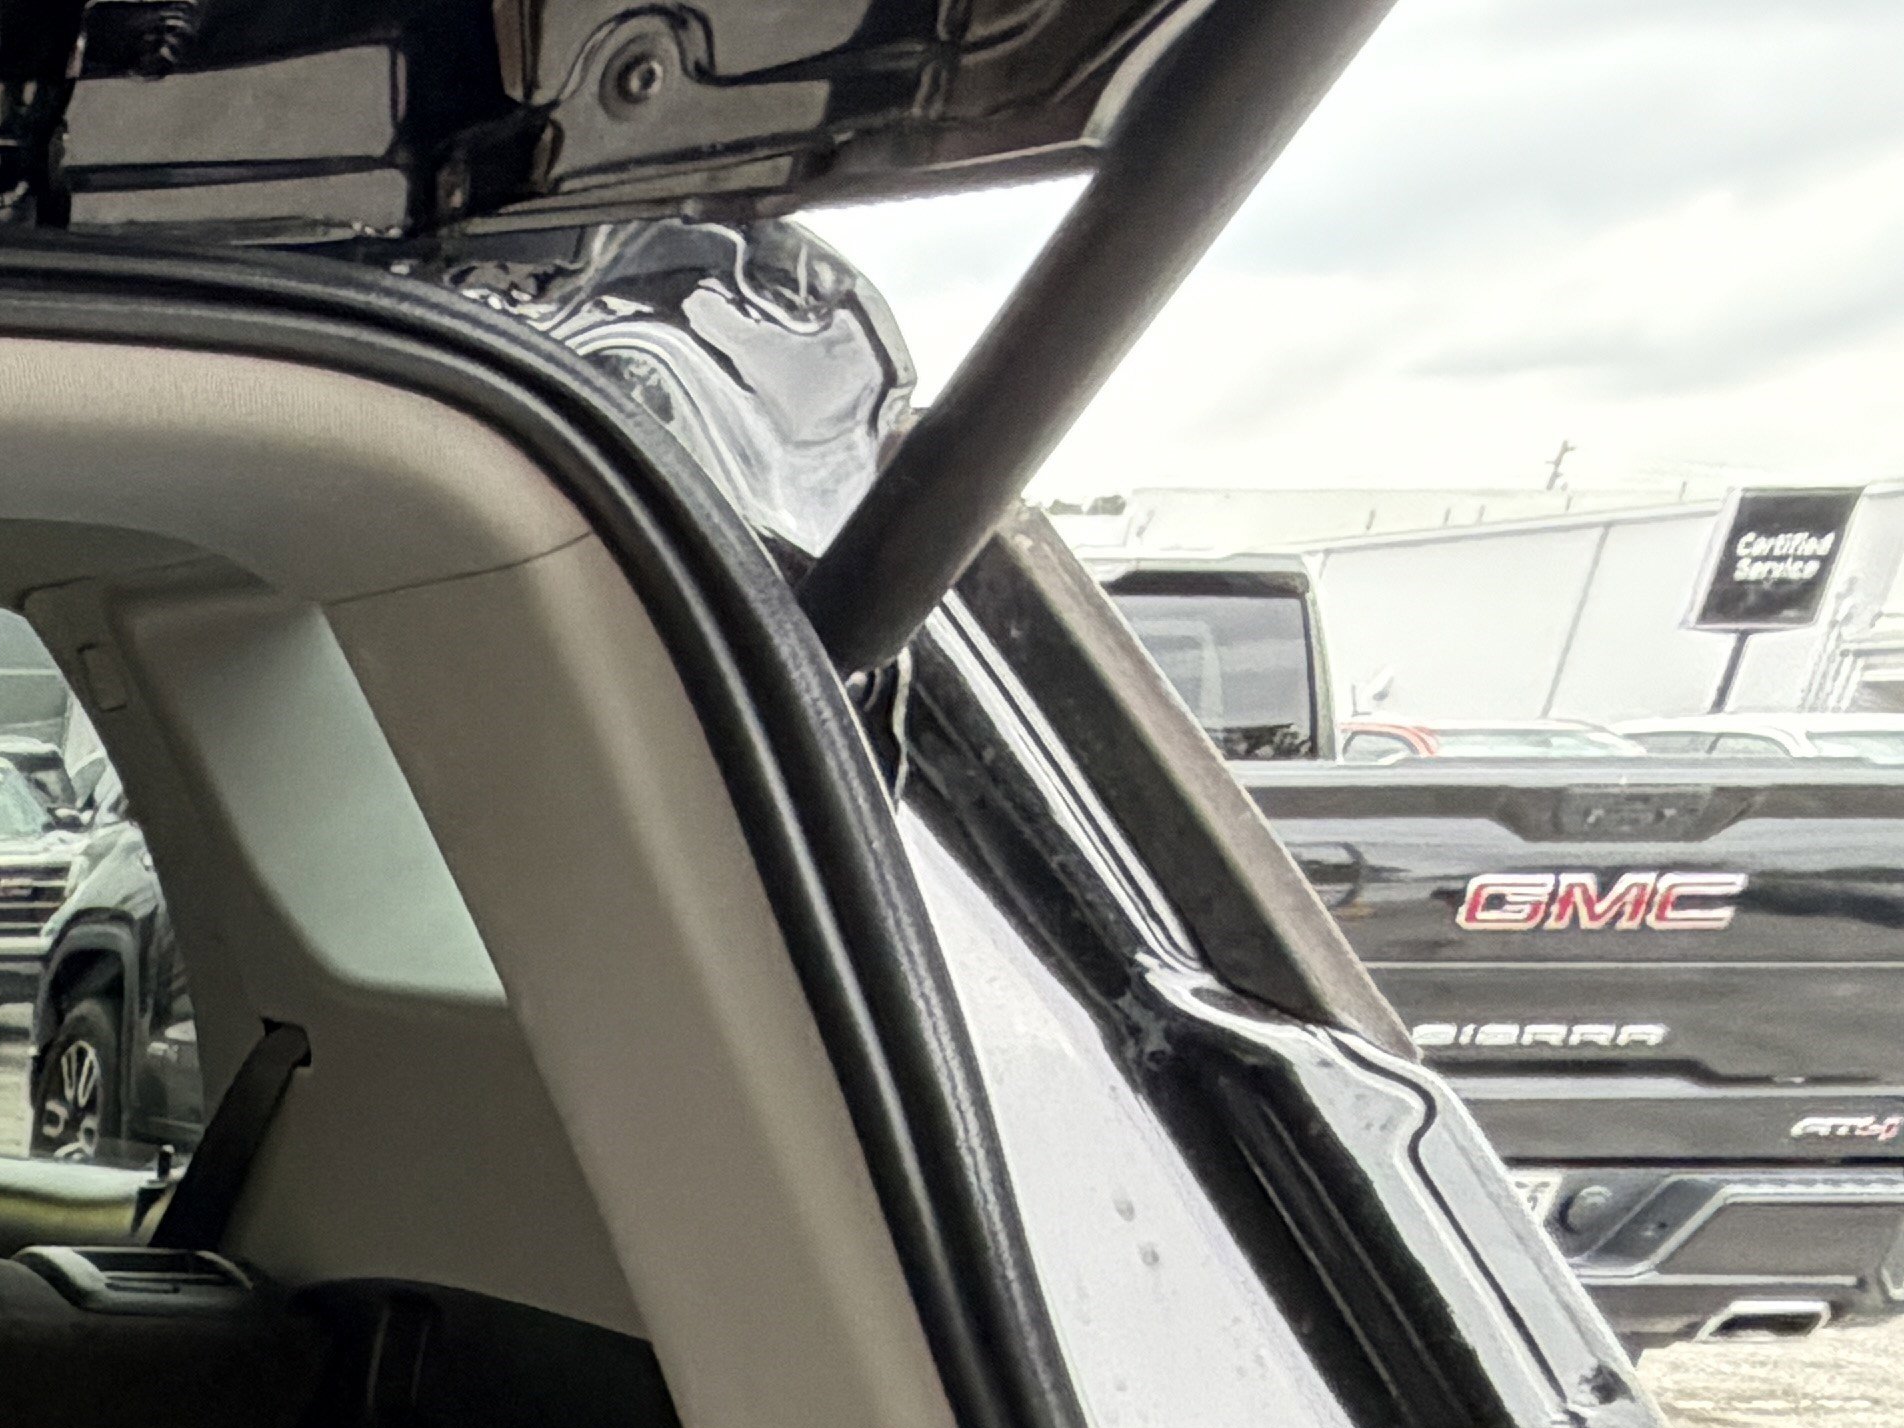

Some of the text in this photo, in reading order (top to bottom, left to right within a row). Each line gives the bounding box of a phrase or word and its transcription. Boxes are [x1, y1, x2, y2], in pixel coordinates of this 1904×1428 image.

[1735, 530, 1836, 557] Certified
[1733, 556, 1821, 582] Service
[1456, 871, 1749, 931] GMC
[1412, 1022, 1671, 1047] SIERRA
